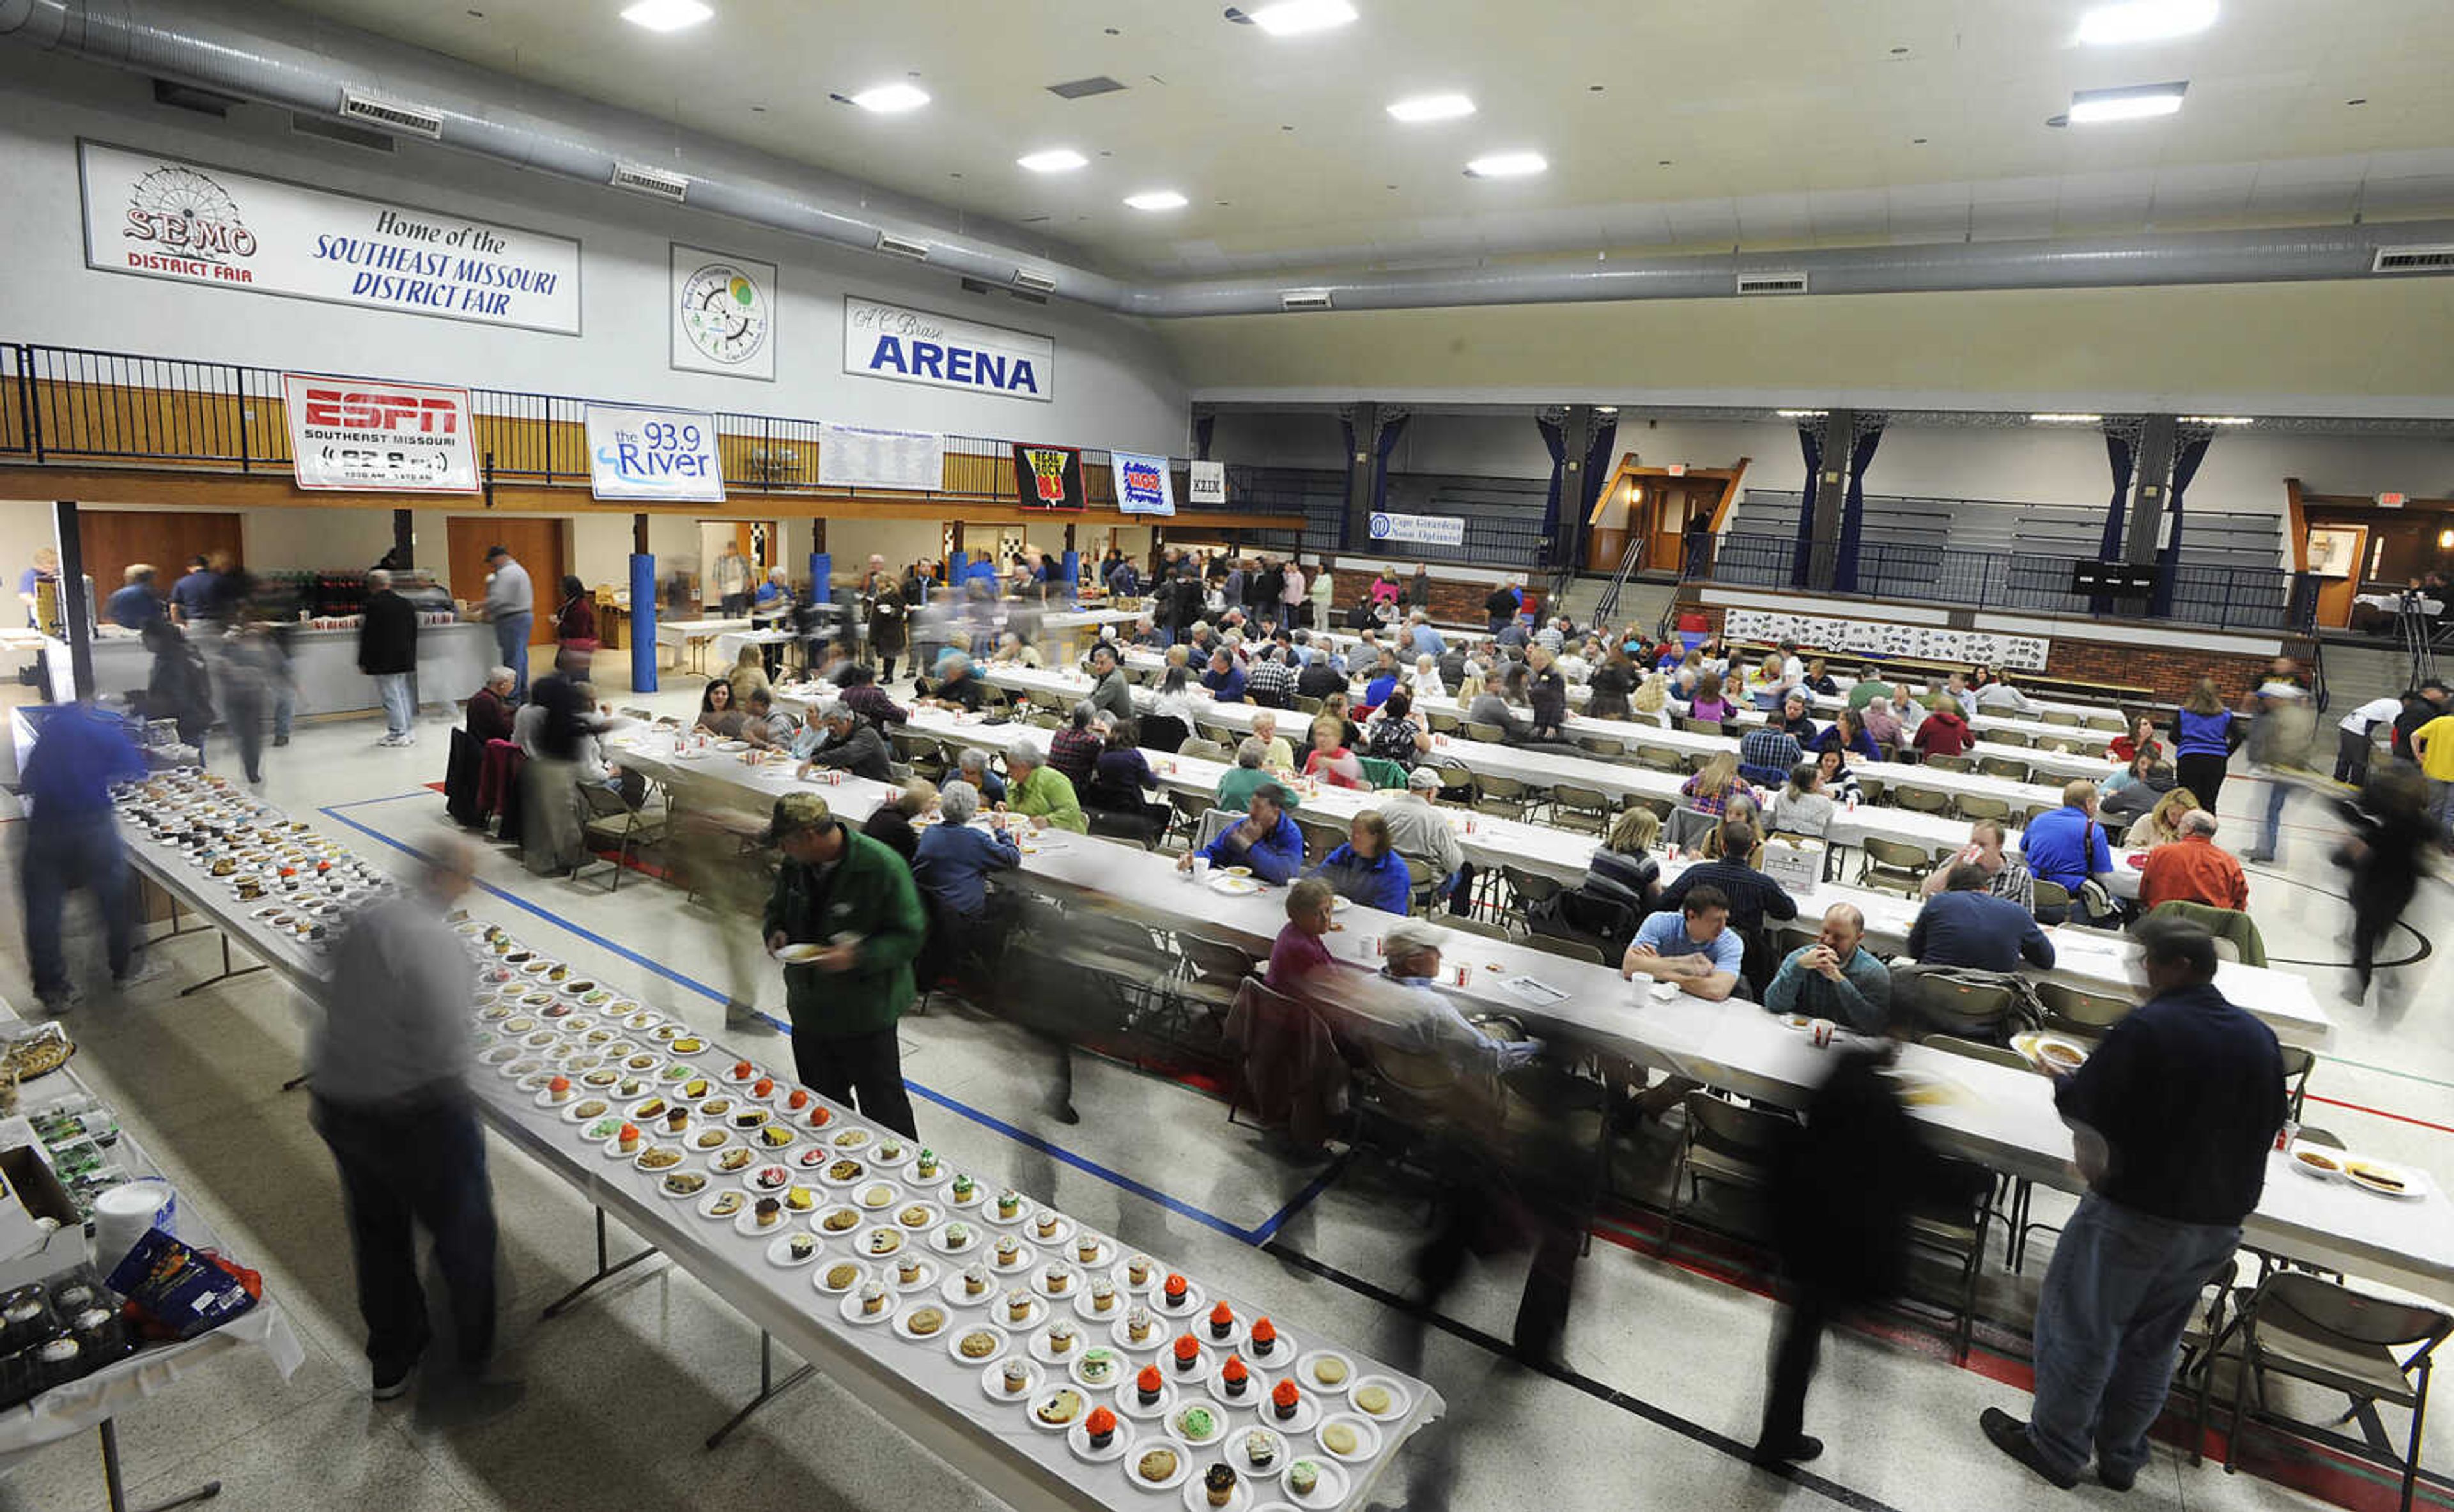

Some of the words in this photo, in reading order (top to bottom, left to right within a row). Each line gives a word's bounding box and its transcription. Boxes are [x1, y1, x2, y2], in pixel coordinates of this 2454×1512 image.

[123, 208, 257, 257] SEMO
[376, 210, 442, 243] Home
[445, 228, 472, 247] of
[472, 233, 506, 254] the
[128, 252, 208, 276] DISTRICT
[214, 266, 252, 283] FAIR
[313, 234, 452, 279] SOUTHEAST
[452, 258, 558, 296] MISSOURI
[352, 272, 458, 308] DISTRICT
[460, 288, 511, 316] FAIR
[869, 334, 1038, 394] ARENA
[306, 389, 456, 433] ESPN
[305, 429, 387, 443] SOUTHEAST
[394, 436, 456, 446] MISSOURI
[615, 429, 638, 443] the
[644, 422, 700, 452] 93.9
[619, 444, 709, 476] River
[1035, 451, 1060, 463] REAL
[1035, 463, 1062, 475] ROCK
